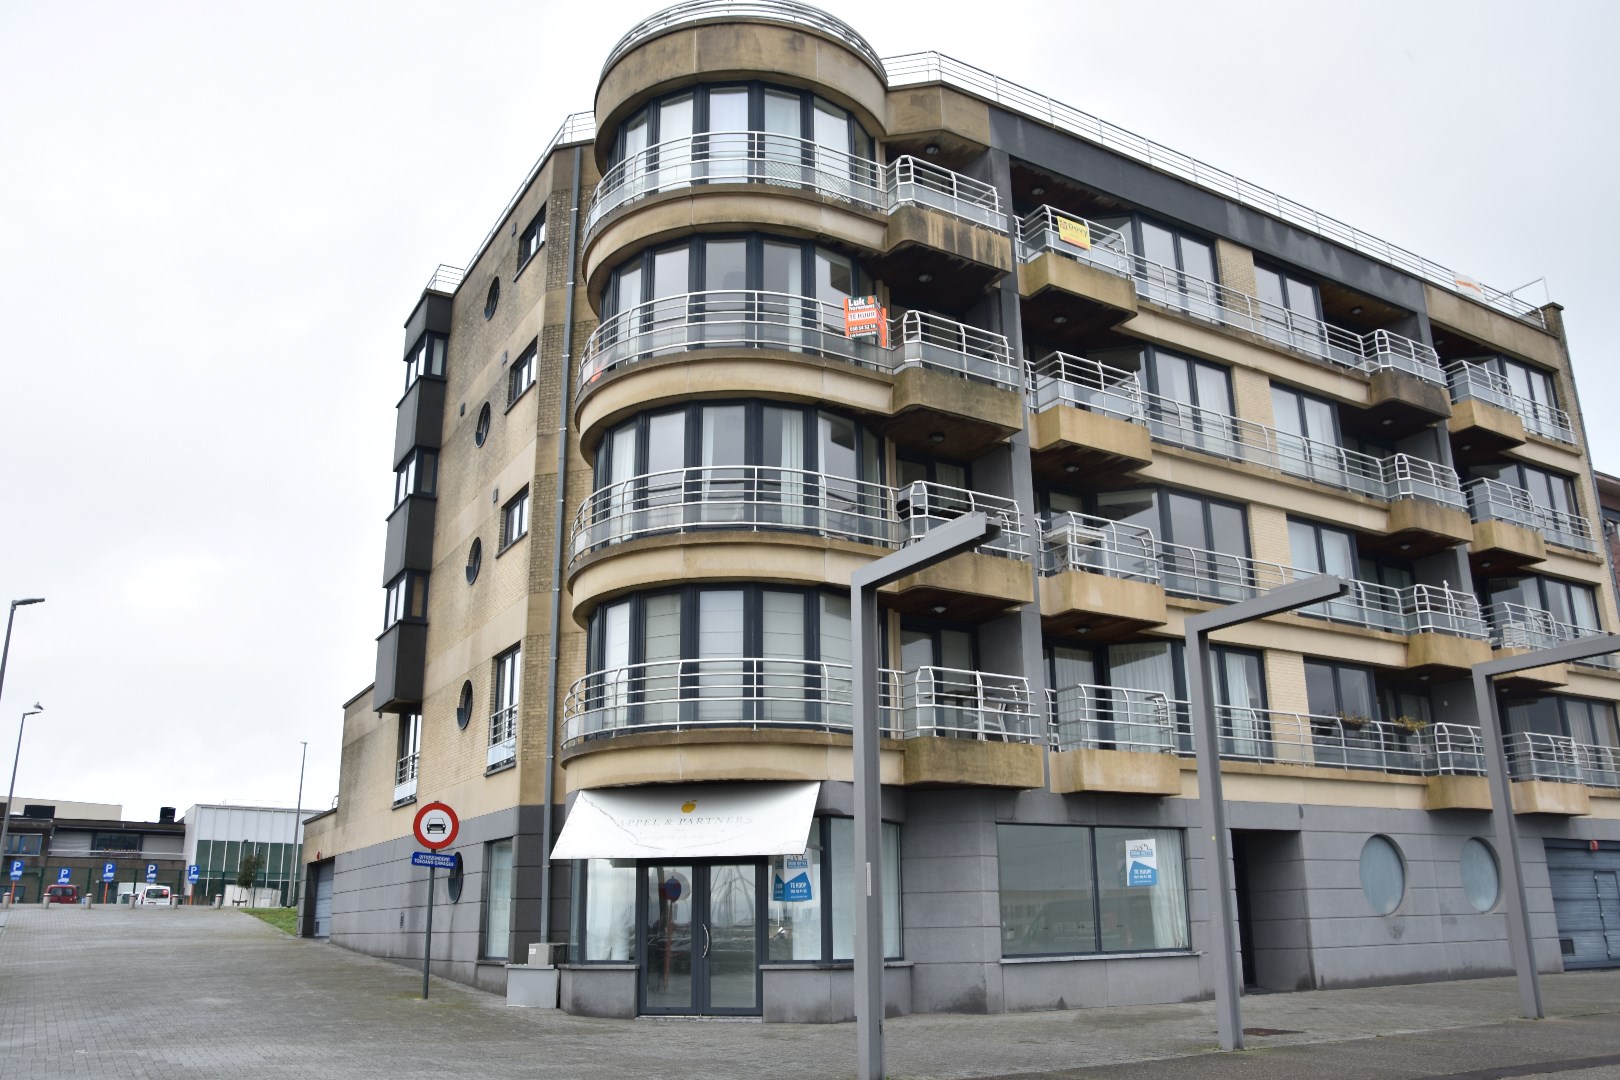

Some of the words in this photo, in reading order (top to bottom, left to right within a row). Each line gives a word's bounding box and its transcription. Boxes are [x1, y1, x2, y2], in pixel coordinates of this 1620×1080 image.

[848, 297, 865, 306] Luk
[857, 311, 875, 319] HUUR
[664, 817, 673, 825] &
[679, 815, 753, 826] PARTNERS
[13, 861, 21, 871] P
[105, 863, 113, 872] P
[147, 864, 156, 873] P
[190, 866, 197, 874] P
[60, 869, 68, 877] P
